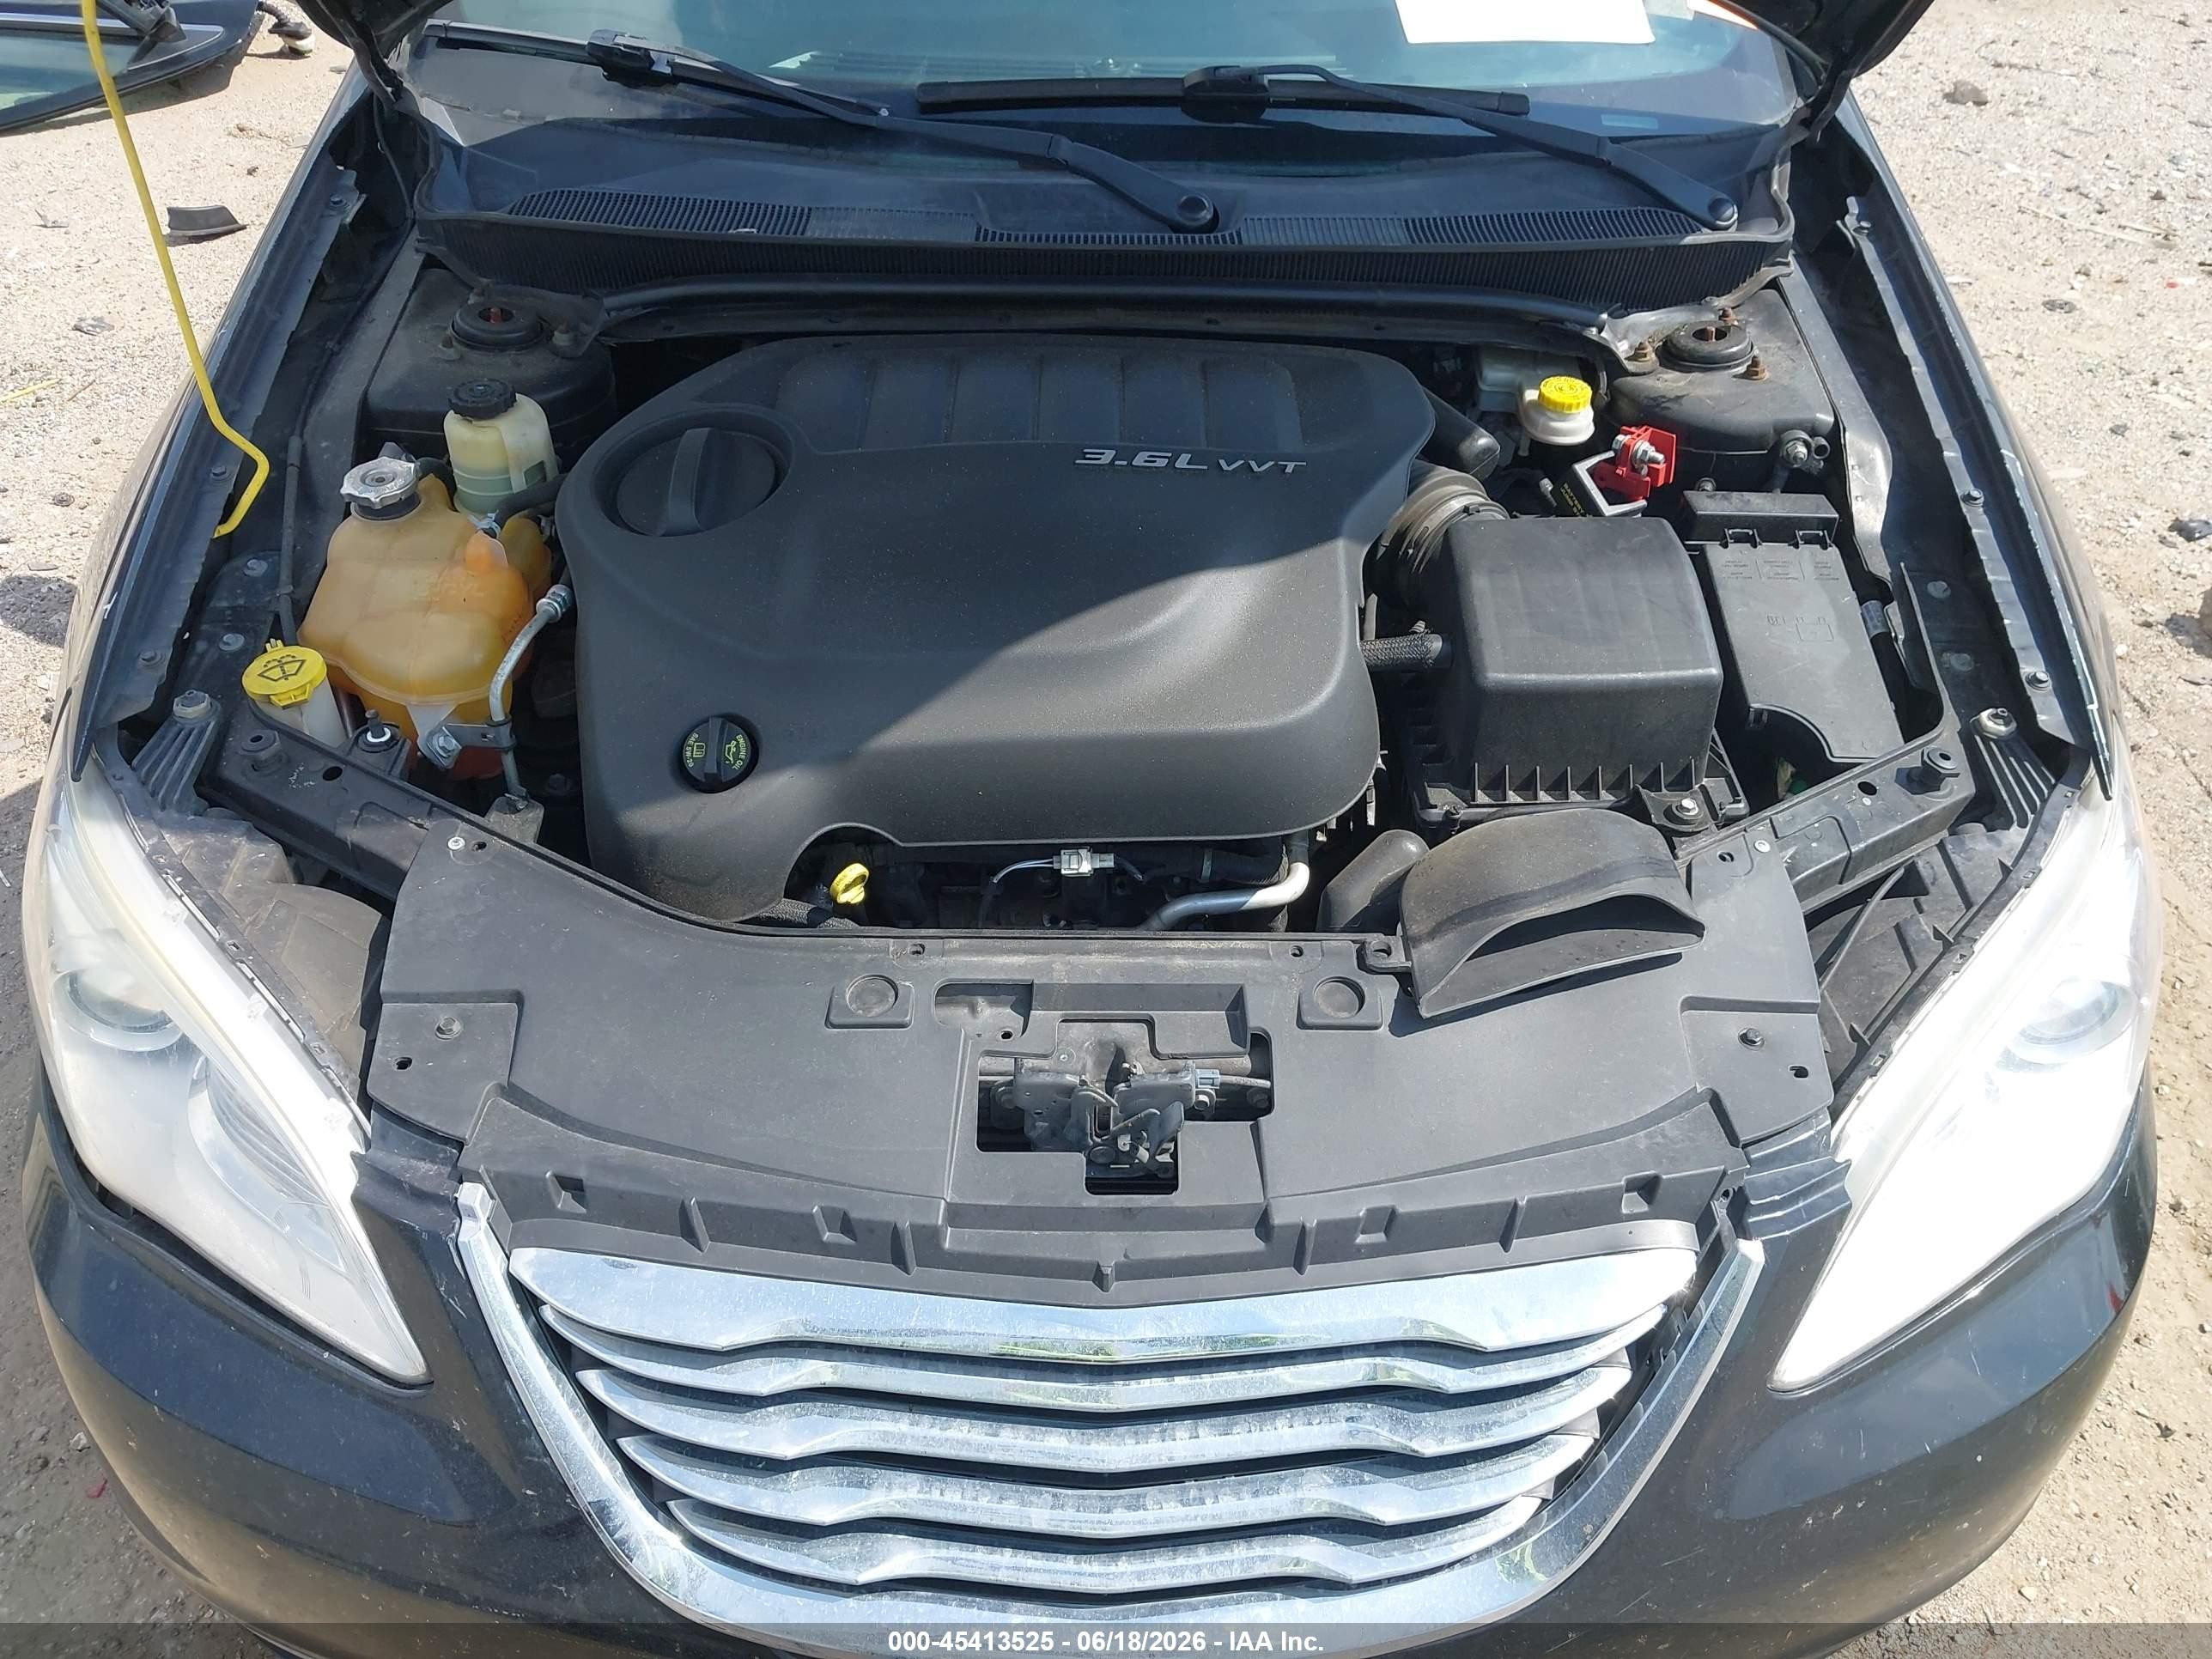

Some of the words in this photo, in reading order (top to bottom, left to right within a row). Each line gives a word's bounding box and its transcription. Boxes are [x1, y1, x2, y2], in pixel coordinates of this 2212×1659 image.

[1075, 448, 1208, 470] 3.6L
[1218, 459, 1307, 473] VVT
[736, 734, 746, 759] ENGINE
[732, 760, 744, 770] OIL
